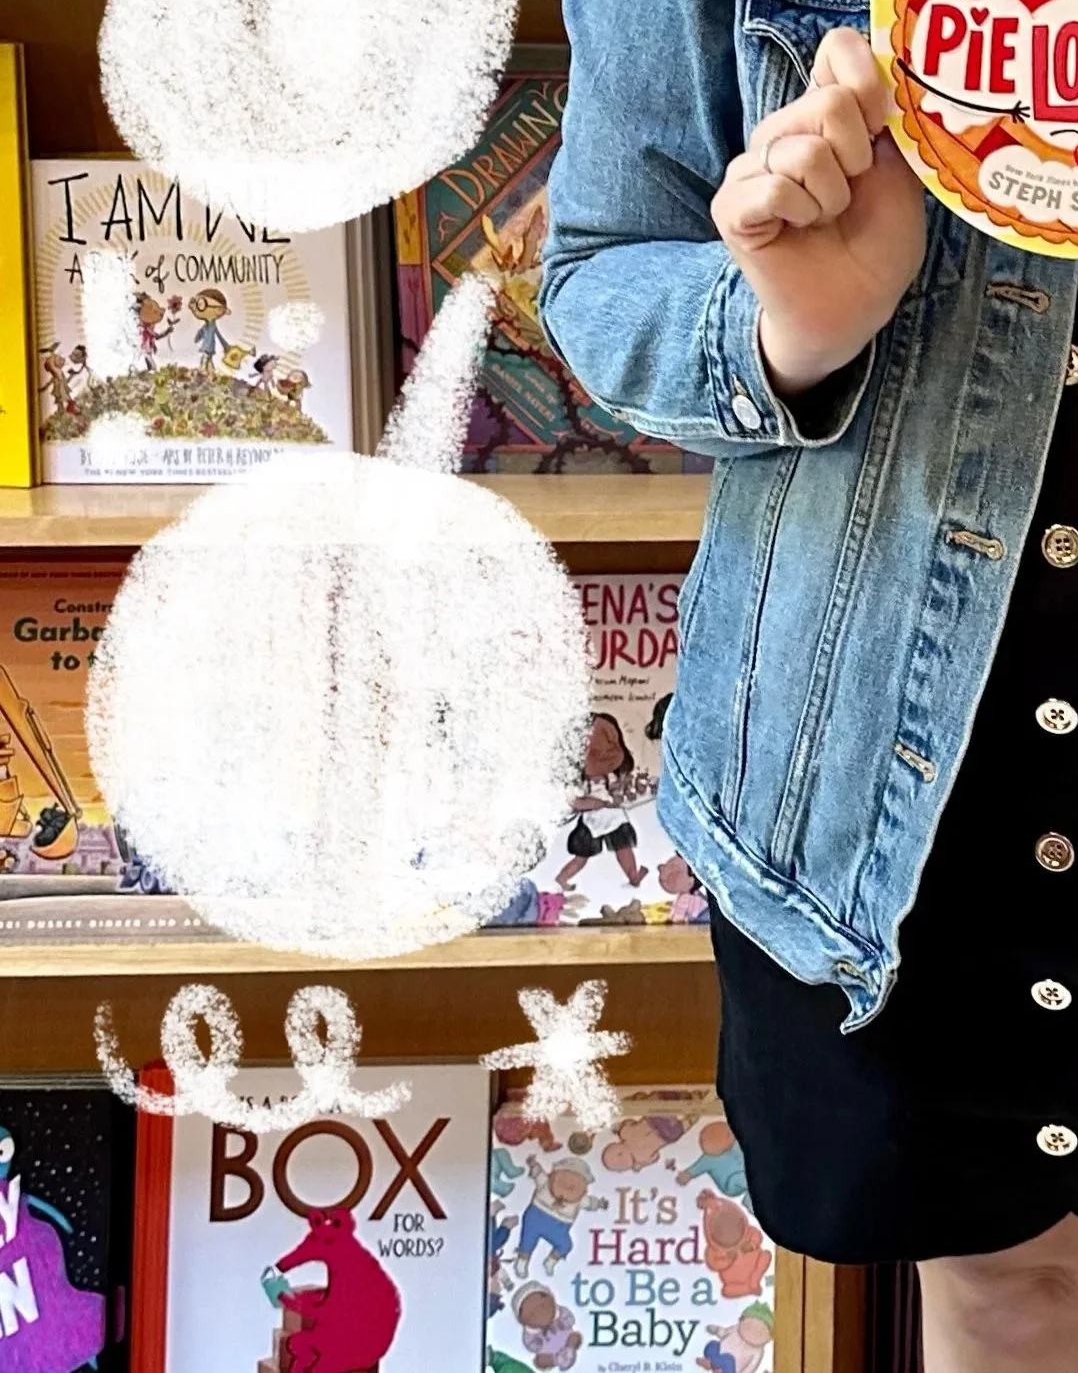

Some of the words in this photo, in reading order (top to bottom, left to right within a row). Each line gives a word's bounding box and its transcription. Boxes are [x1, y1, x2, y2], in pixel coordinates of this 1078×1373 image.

[438, 100, 559, 211] DRAWN
[48, 172, 89, 245] I
[101, 173, 184, 242] AM
[988, 171, 1063, 210] STEPH
[145, 254, 170, 294] of
[174, 253, 284, 284] COMMUNITY
[235, 446, 285, 466] REYNO
[574, 582, 680, 625] ENA'S
[51, 650, 81, 671] to
[209, 1118, 452, 1223] BOX
[394, 1213, 425, 1232] FOR
[614, 1186, 678, 1226] It's
[378, 1237, 444, 1258] WORDS?
[587, 1226, 704, 1266] Hard
[571, 1273, 616, 1307] to
[625, 1269, 681, 1306] Be
[691, 1276, 718, 1306] a
[588, 1308, 700, 1356] Baby
[608, 1361, 641, 1373] Cheryl
[655, 1361, 683, 1372] Klein
